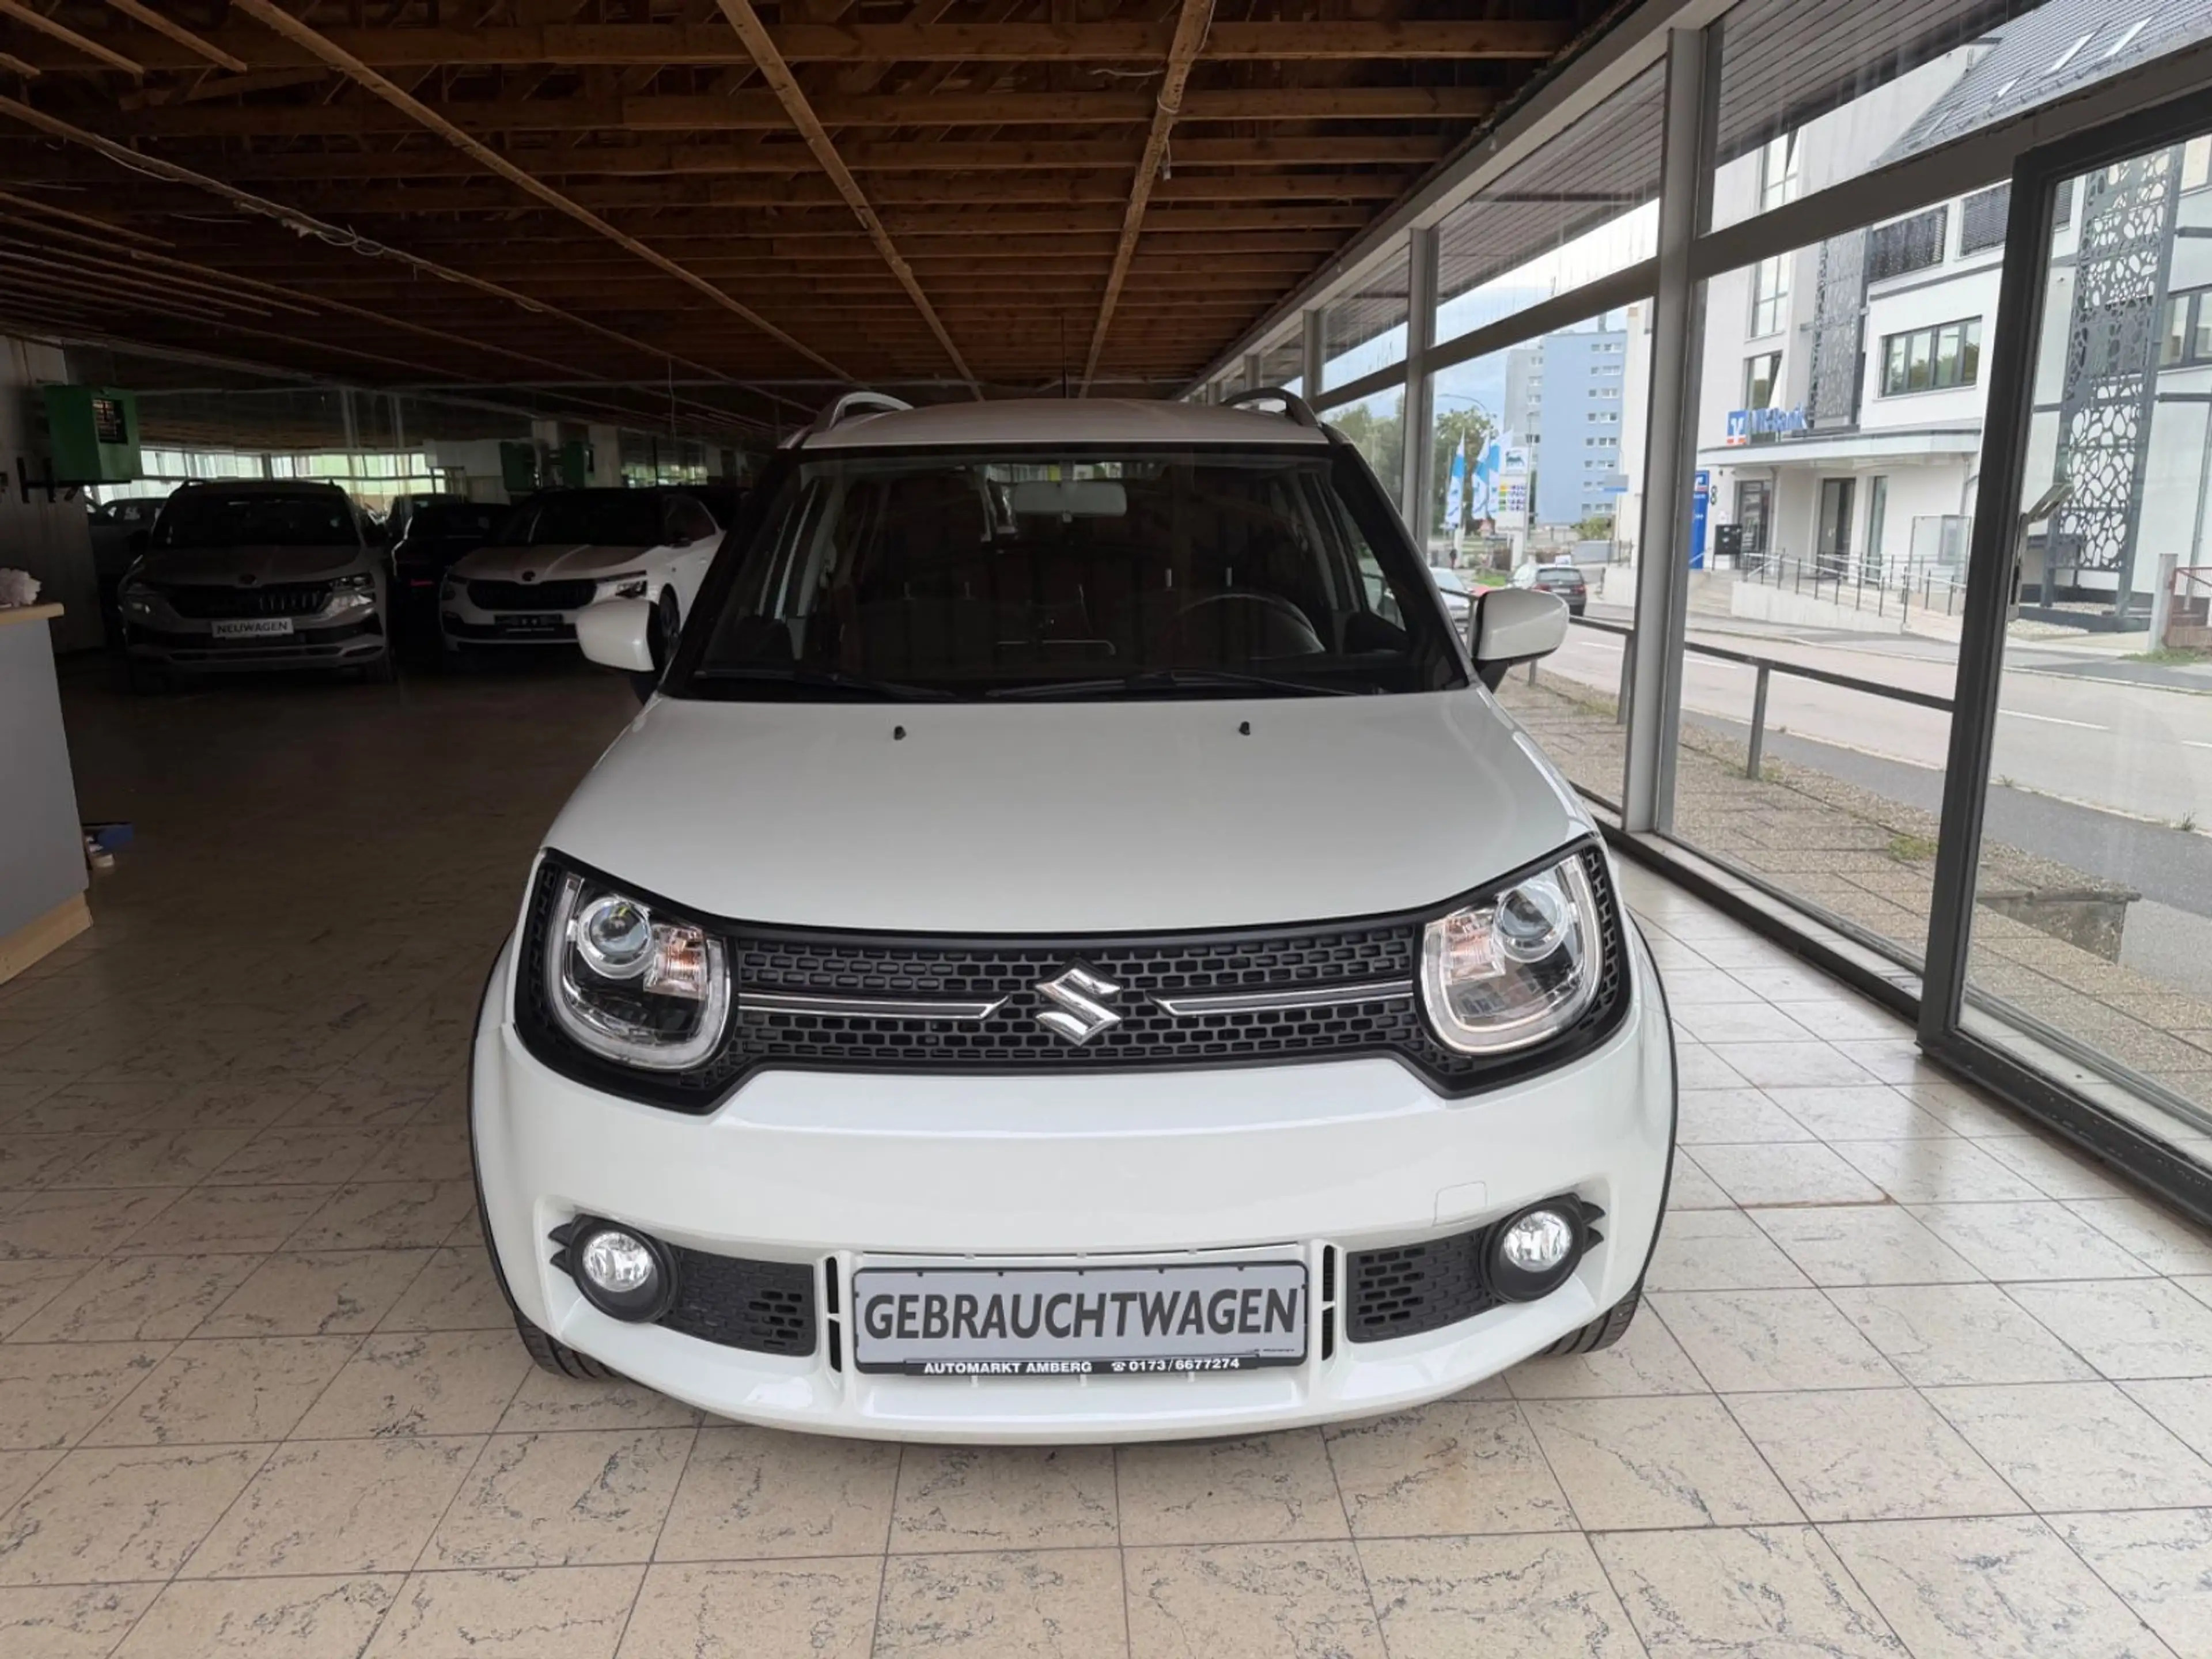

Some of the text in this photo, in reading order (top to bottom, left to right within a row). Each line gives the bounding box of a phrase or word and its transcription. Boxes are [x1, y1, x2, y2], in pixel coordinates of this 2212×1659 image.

[217, 621, 288, 634] NEUWAGEN
[865, 1288, 1297, 1339] GEBRAUCHTWAGEN
[924, 1357, 1240, 1373] AUTOMARKT AMBERG 0173/6677274
